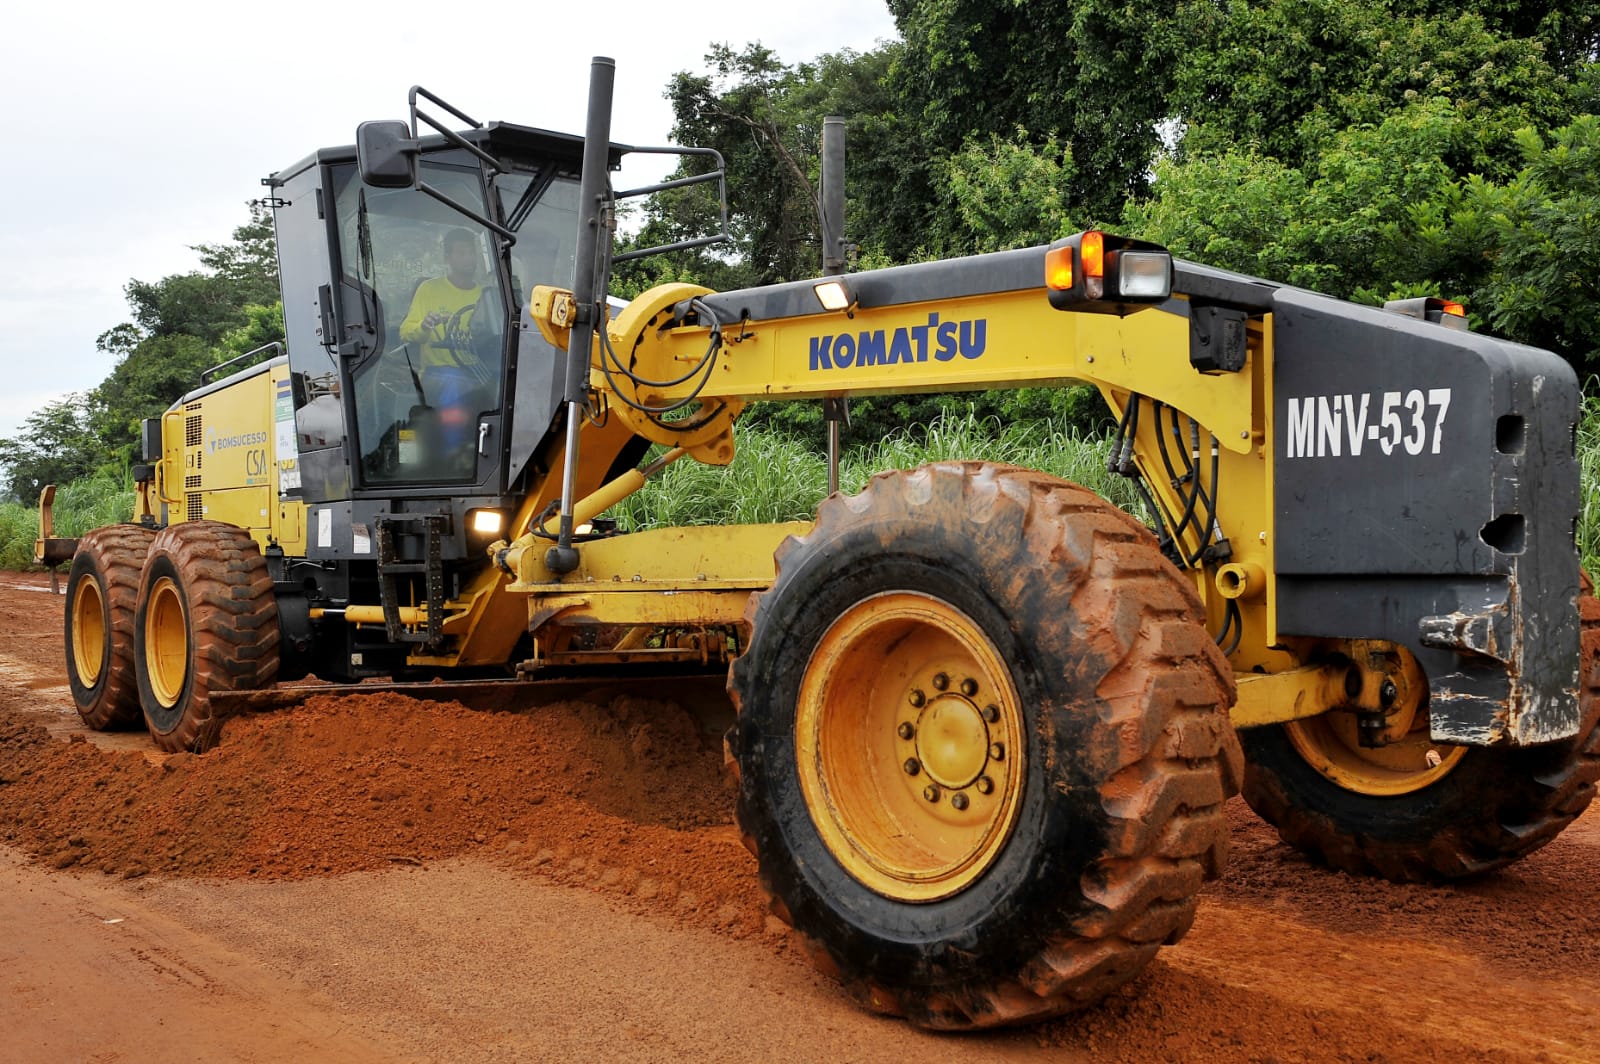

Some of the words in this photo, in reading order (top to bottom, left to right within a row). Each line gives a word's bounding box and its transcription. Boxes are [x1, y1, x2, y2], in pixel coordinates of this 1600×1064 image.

[809, 312, 986, 370] KOMATSU
[217, 431, 267, 449] BOMSUCESSO
[1287, 388, 1452, 459] MNV-537
[246, 449, 267, 475] CSA
